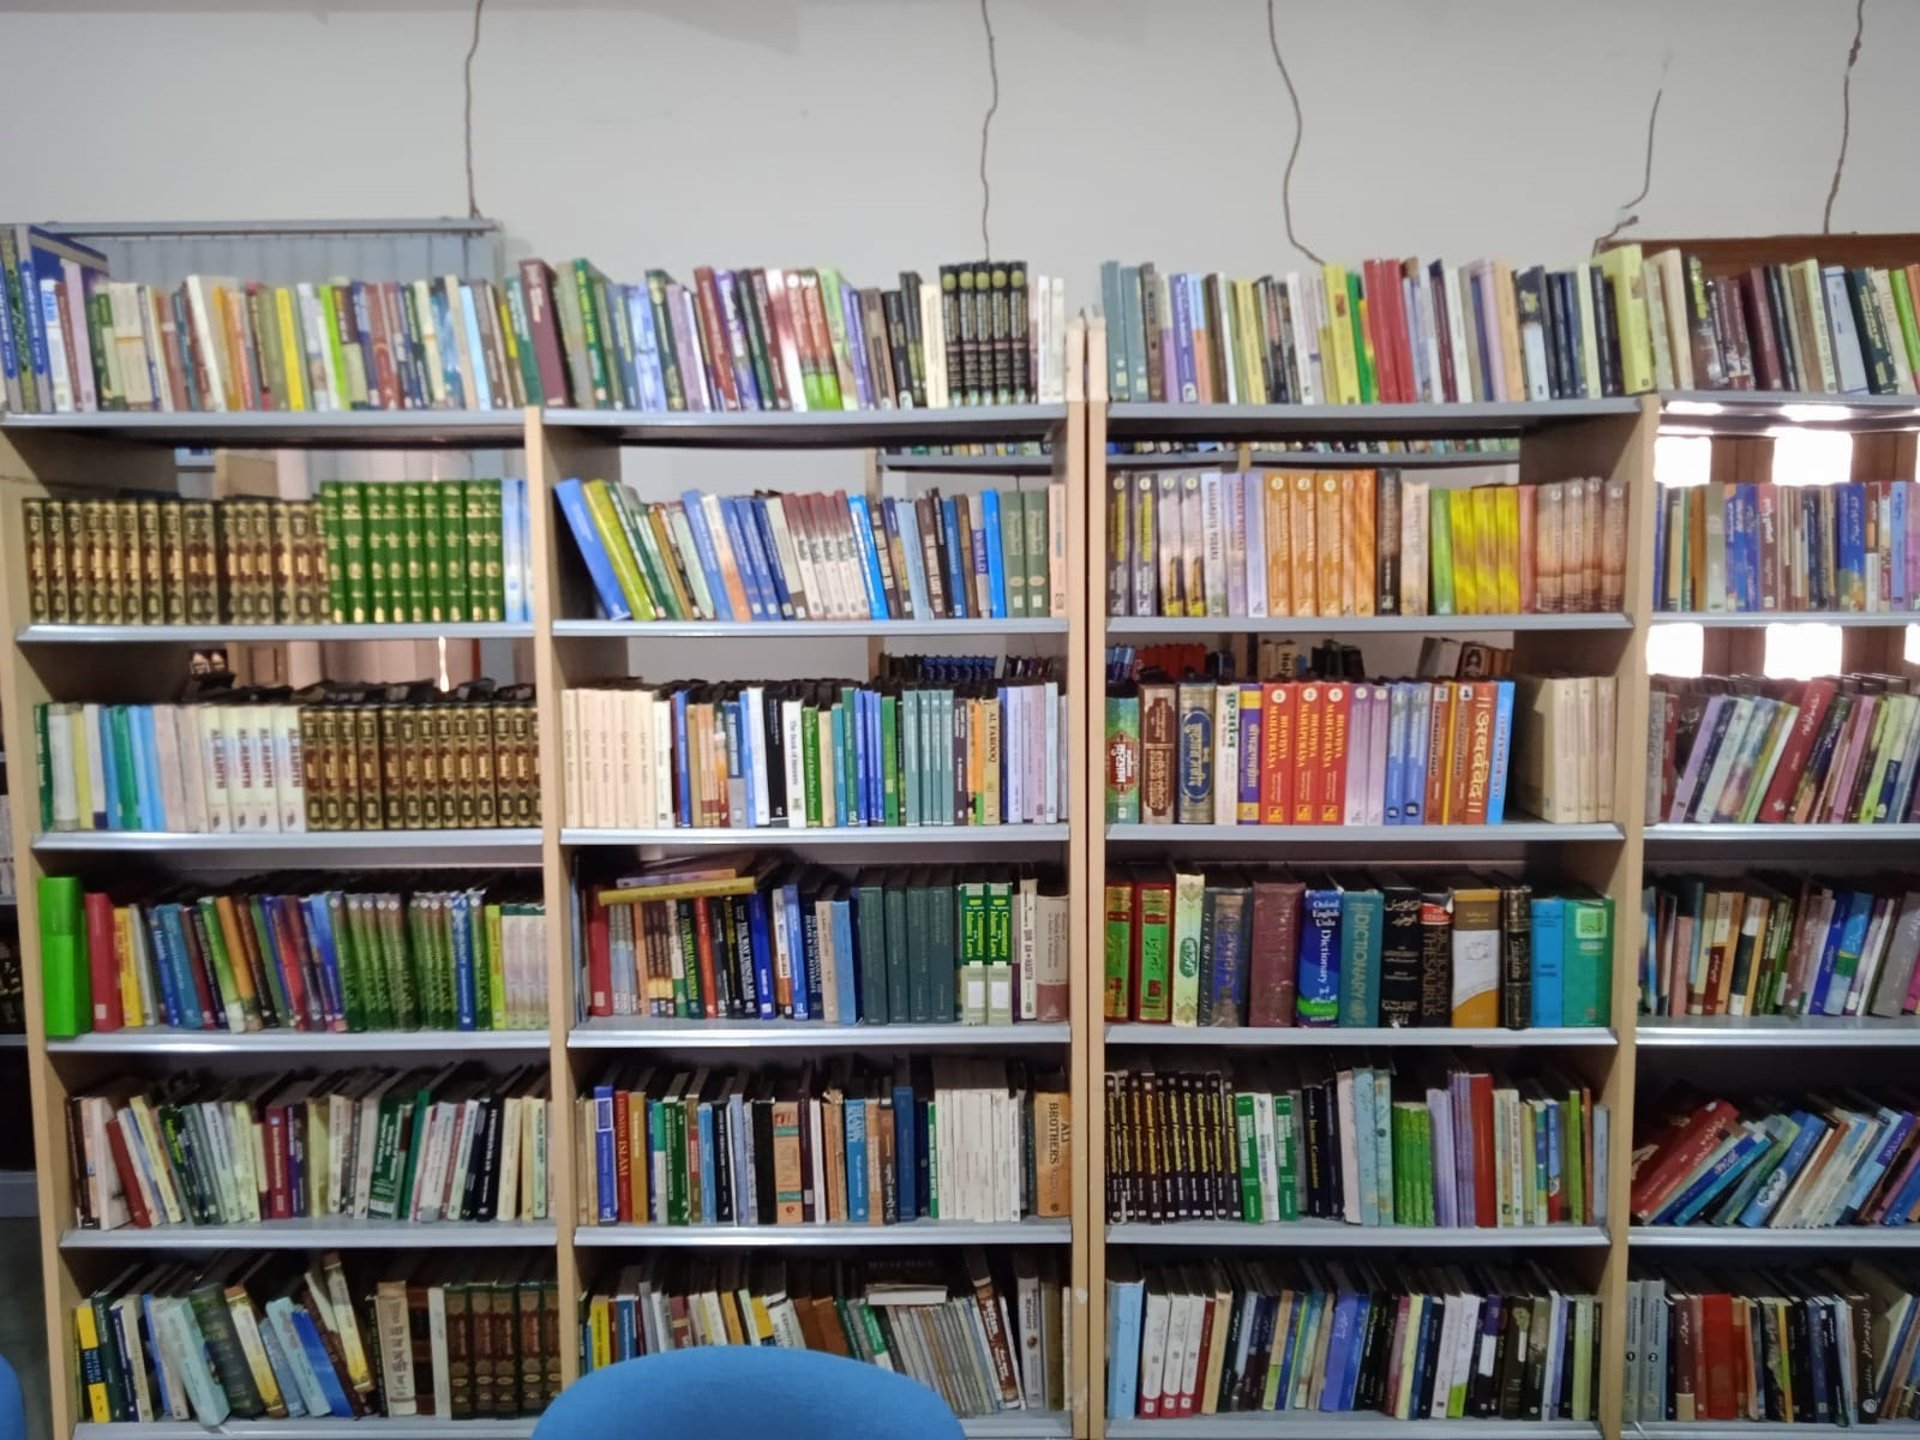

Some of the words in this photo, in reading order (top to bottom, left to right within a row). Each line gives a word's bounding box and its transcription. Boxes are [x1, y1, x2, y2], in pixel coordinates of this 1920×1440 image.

[1317, 929, 1332, 983] Dictionary
[1352, 914, 1370, 999] DICTIONARY
[1422, 931, 1438, 1016] THESAURUS
[1049, 1102, 1060, 1164] BROTHERS
[1060, 1122, 1071, 1142] ALI
[1148, 1129, 1156, 1174] Fundamentals
[1161, 1126, 1169, 1172] Fundamentals
[1173, 1124, 1181, 1171] Fundamentals
[1183, 1092, 1191, 1125] Computer
[1187, 1126, 1195, 1172] Fundamentals
[1199, 1127, 1207, 1172] Fundamentals
[1214, 1126, 1222, 1171] Fundamentals
[1227, 1128, 1236, 1173] Fundamentals
[618, 1140, 629, 1176] ISLAM
